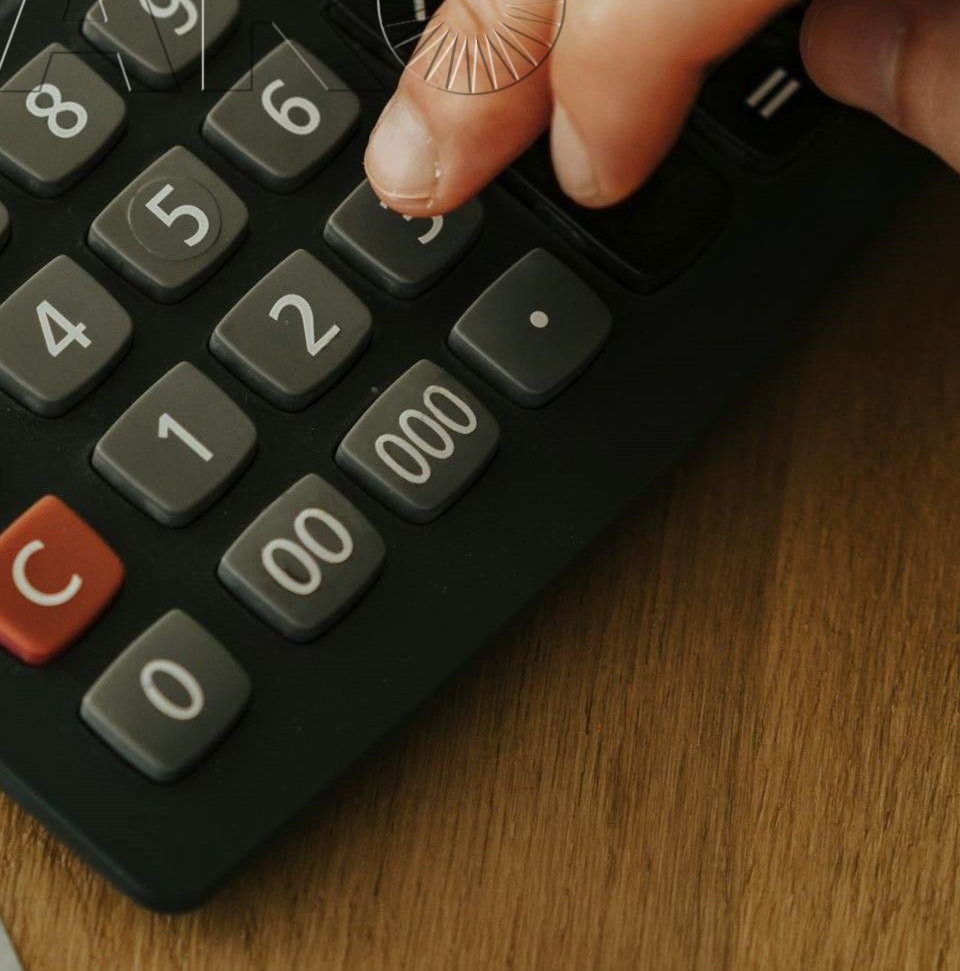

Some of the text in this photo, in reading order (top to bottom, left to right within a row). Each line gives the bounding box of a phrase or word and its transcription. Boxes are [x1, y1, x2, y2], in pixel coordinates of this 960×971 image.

[25, 83, 88, 139] 8
[261, 79, 321, 135] 6
[144, 183, 210, 247] 5
[35, 299, 92, 357] 4
[268, 293, 341, 357] 2
[158, 412, 214, 462] 1
[374, 384, 478, 484] 000
[12, 540, 83, 606] C
[261, 507, 354, 595] 00
[140, 659, 204, 721] 0
